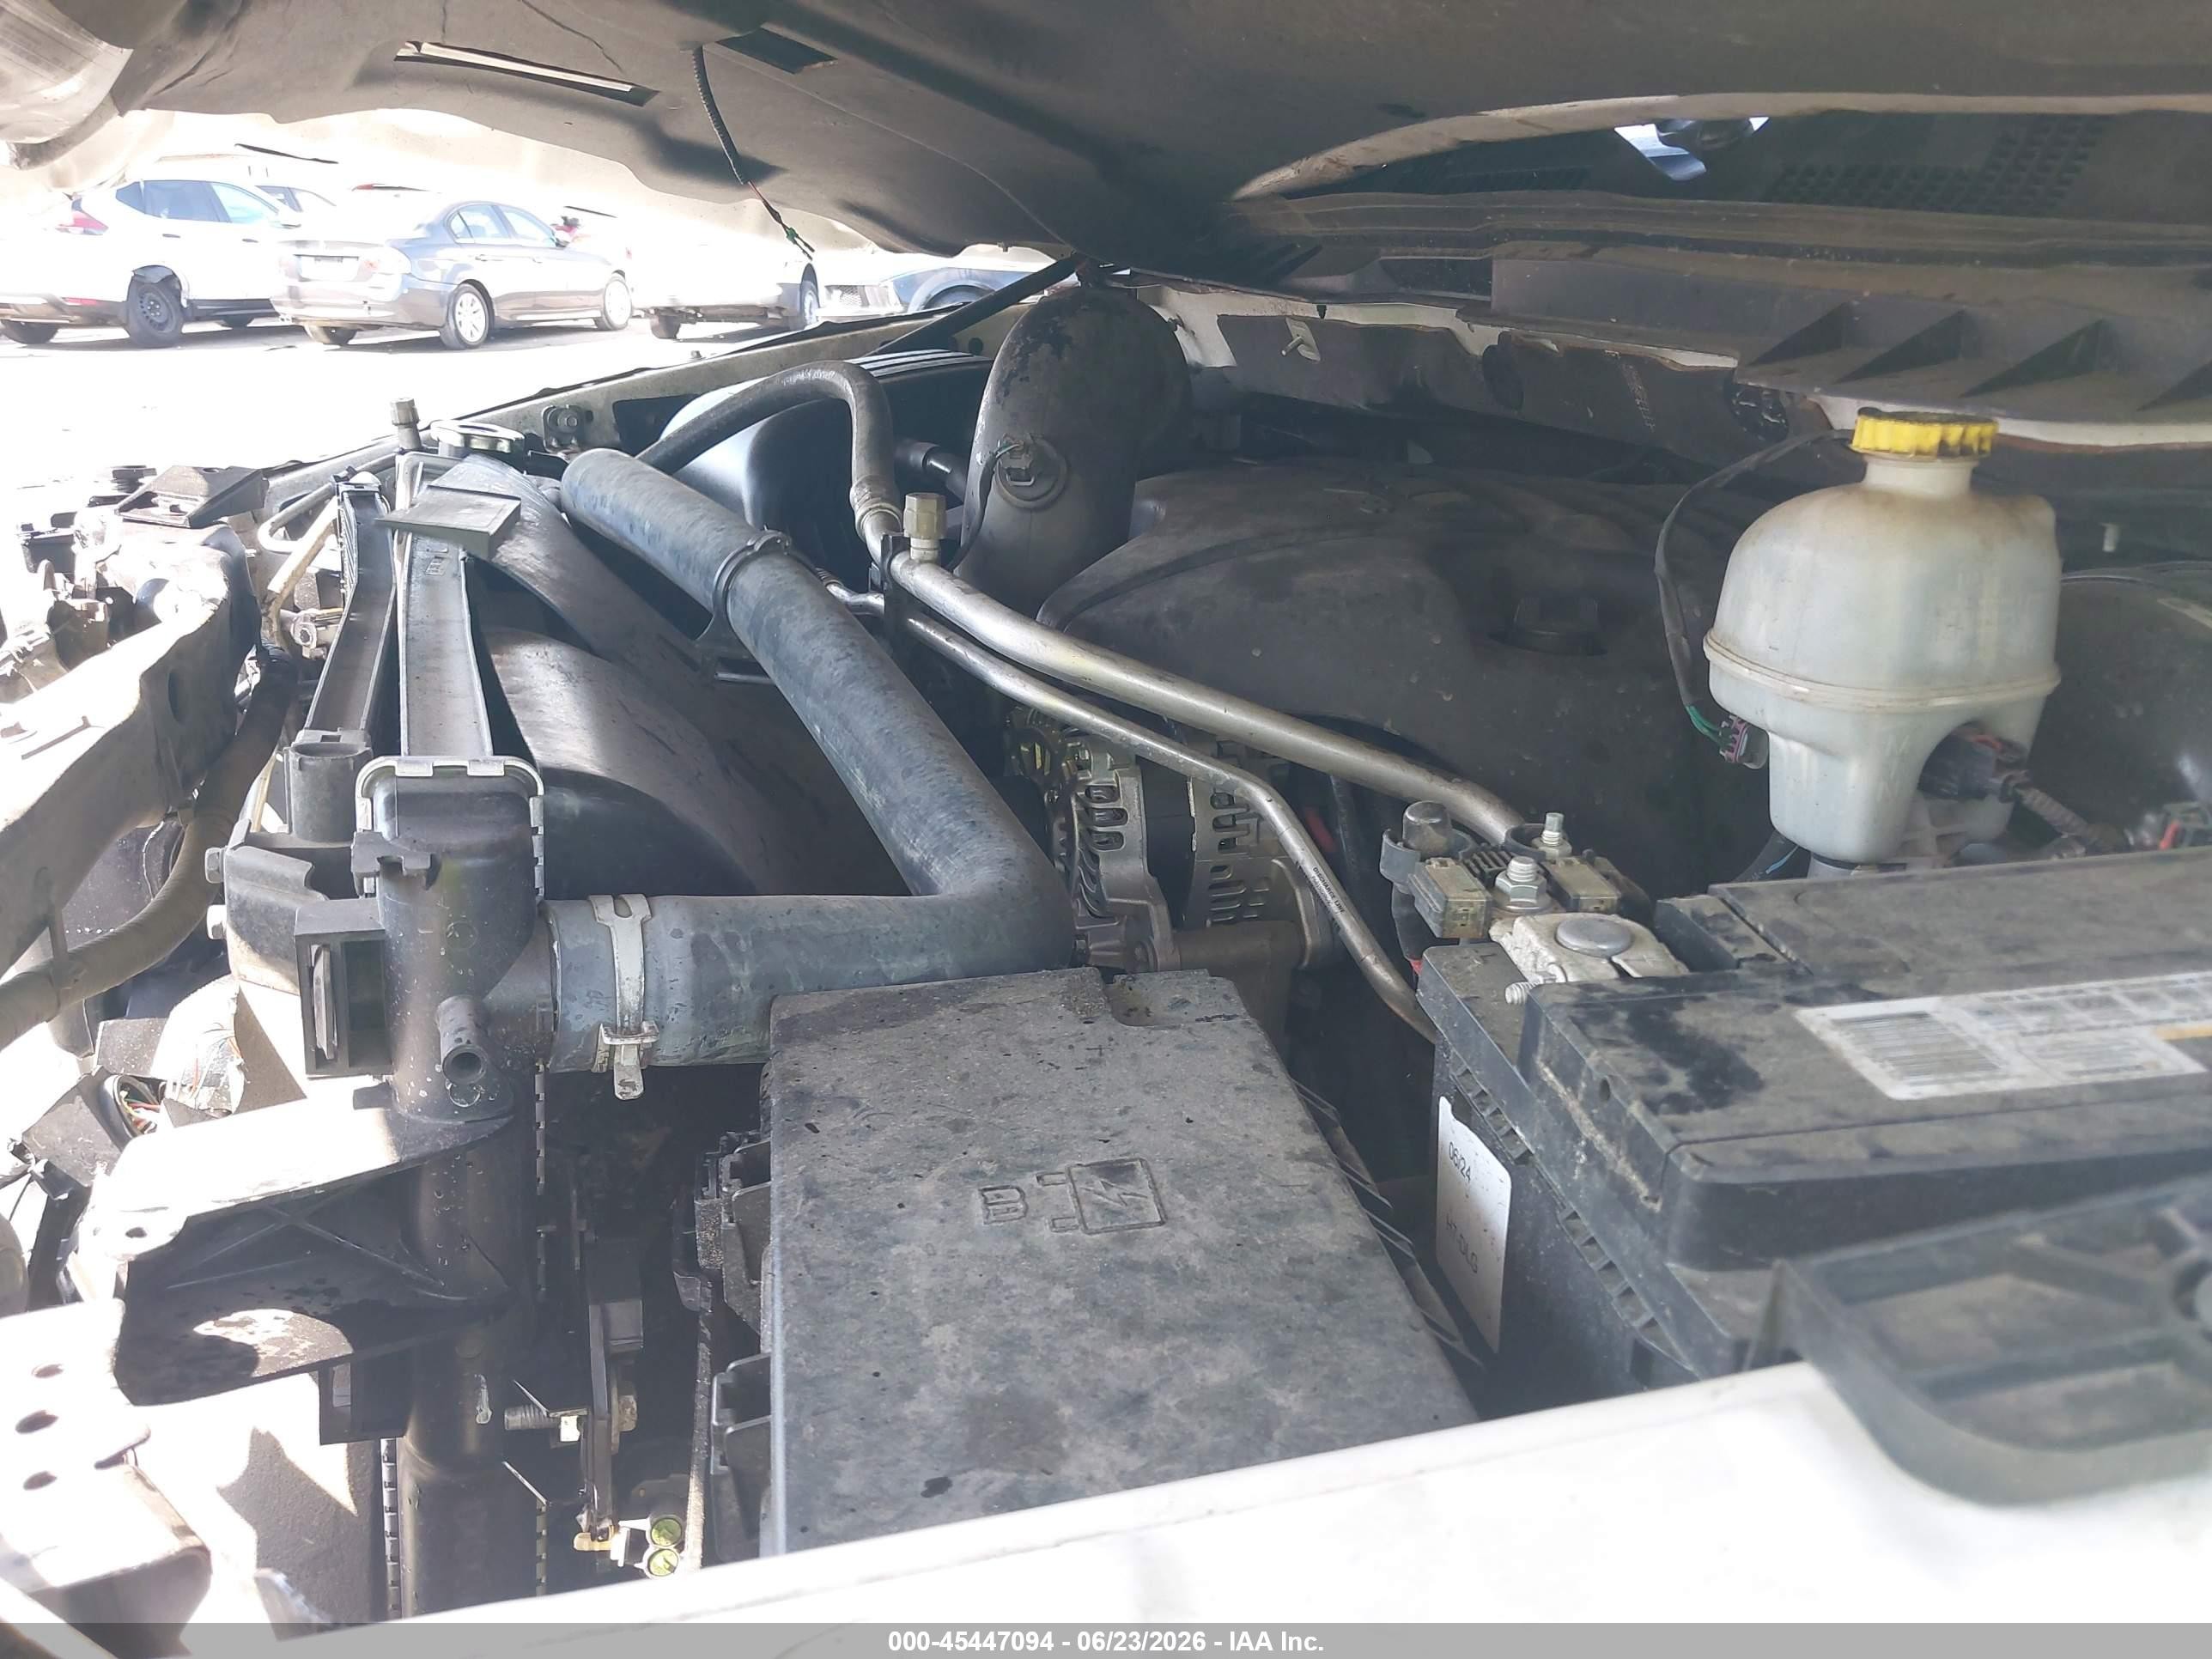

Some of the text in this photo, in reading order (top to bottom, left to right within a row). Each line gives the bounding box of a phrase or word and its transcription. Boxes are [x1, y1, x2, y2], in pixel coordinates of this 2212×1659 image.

[1312, 866, 1336, 899] DISCHARGE
[1334, 899, 1346, 914] LINE
[1449, 1141, 1471, 1183] 06/24
